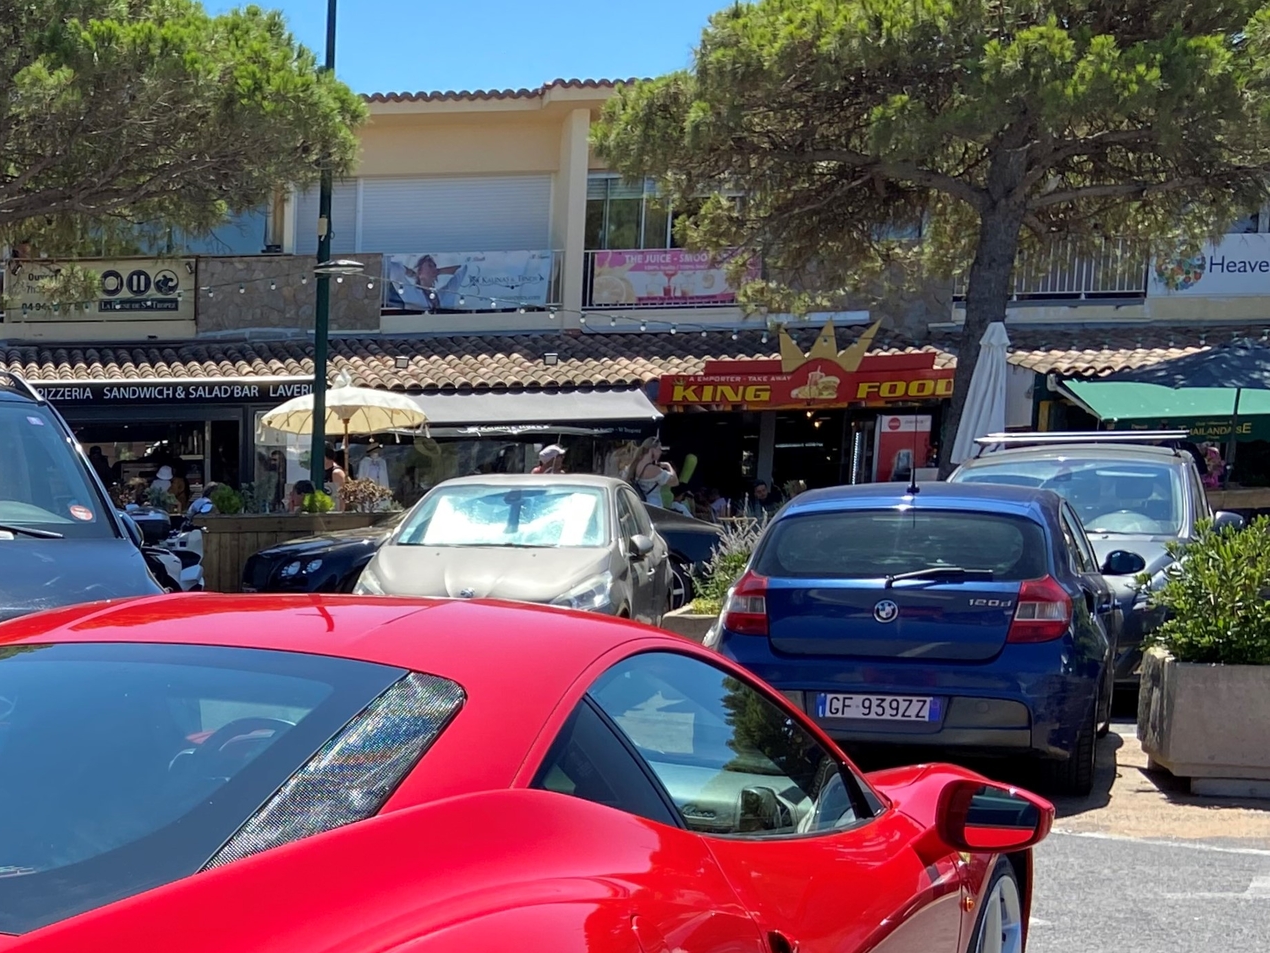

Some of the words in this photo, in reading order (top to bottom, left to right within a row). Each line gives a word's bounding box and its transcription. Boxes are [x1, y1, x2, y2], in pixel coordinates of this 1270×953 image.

[644, 254, 671, 263] JUICE
[104, 386, 172, 399] SANDWICH
[176, 386, 186, 398] &
[672, 385, 772, 402] KING
[856, 378, 954, 398] FOOD
[968, 598, 1012, 607] 120d
[830, 696, 853, 716] GF
[861, 699, 926, 718] 939ZZ
